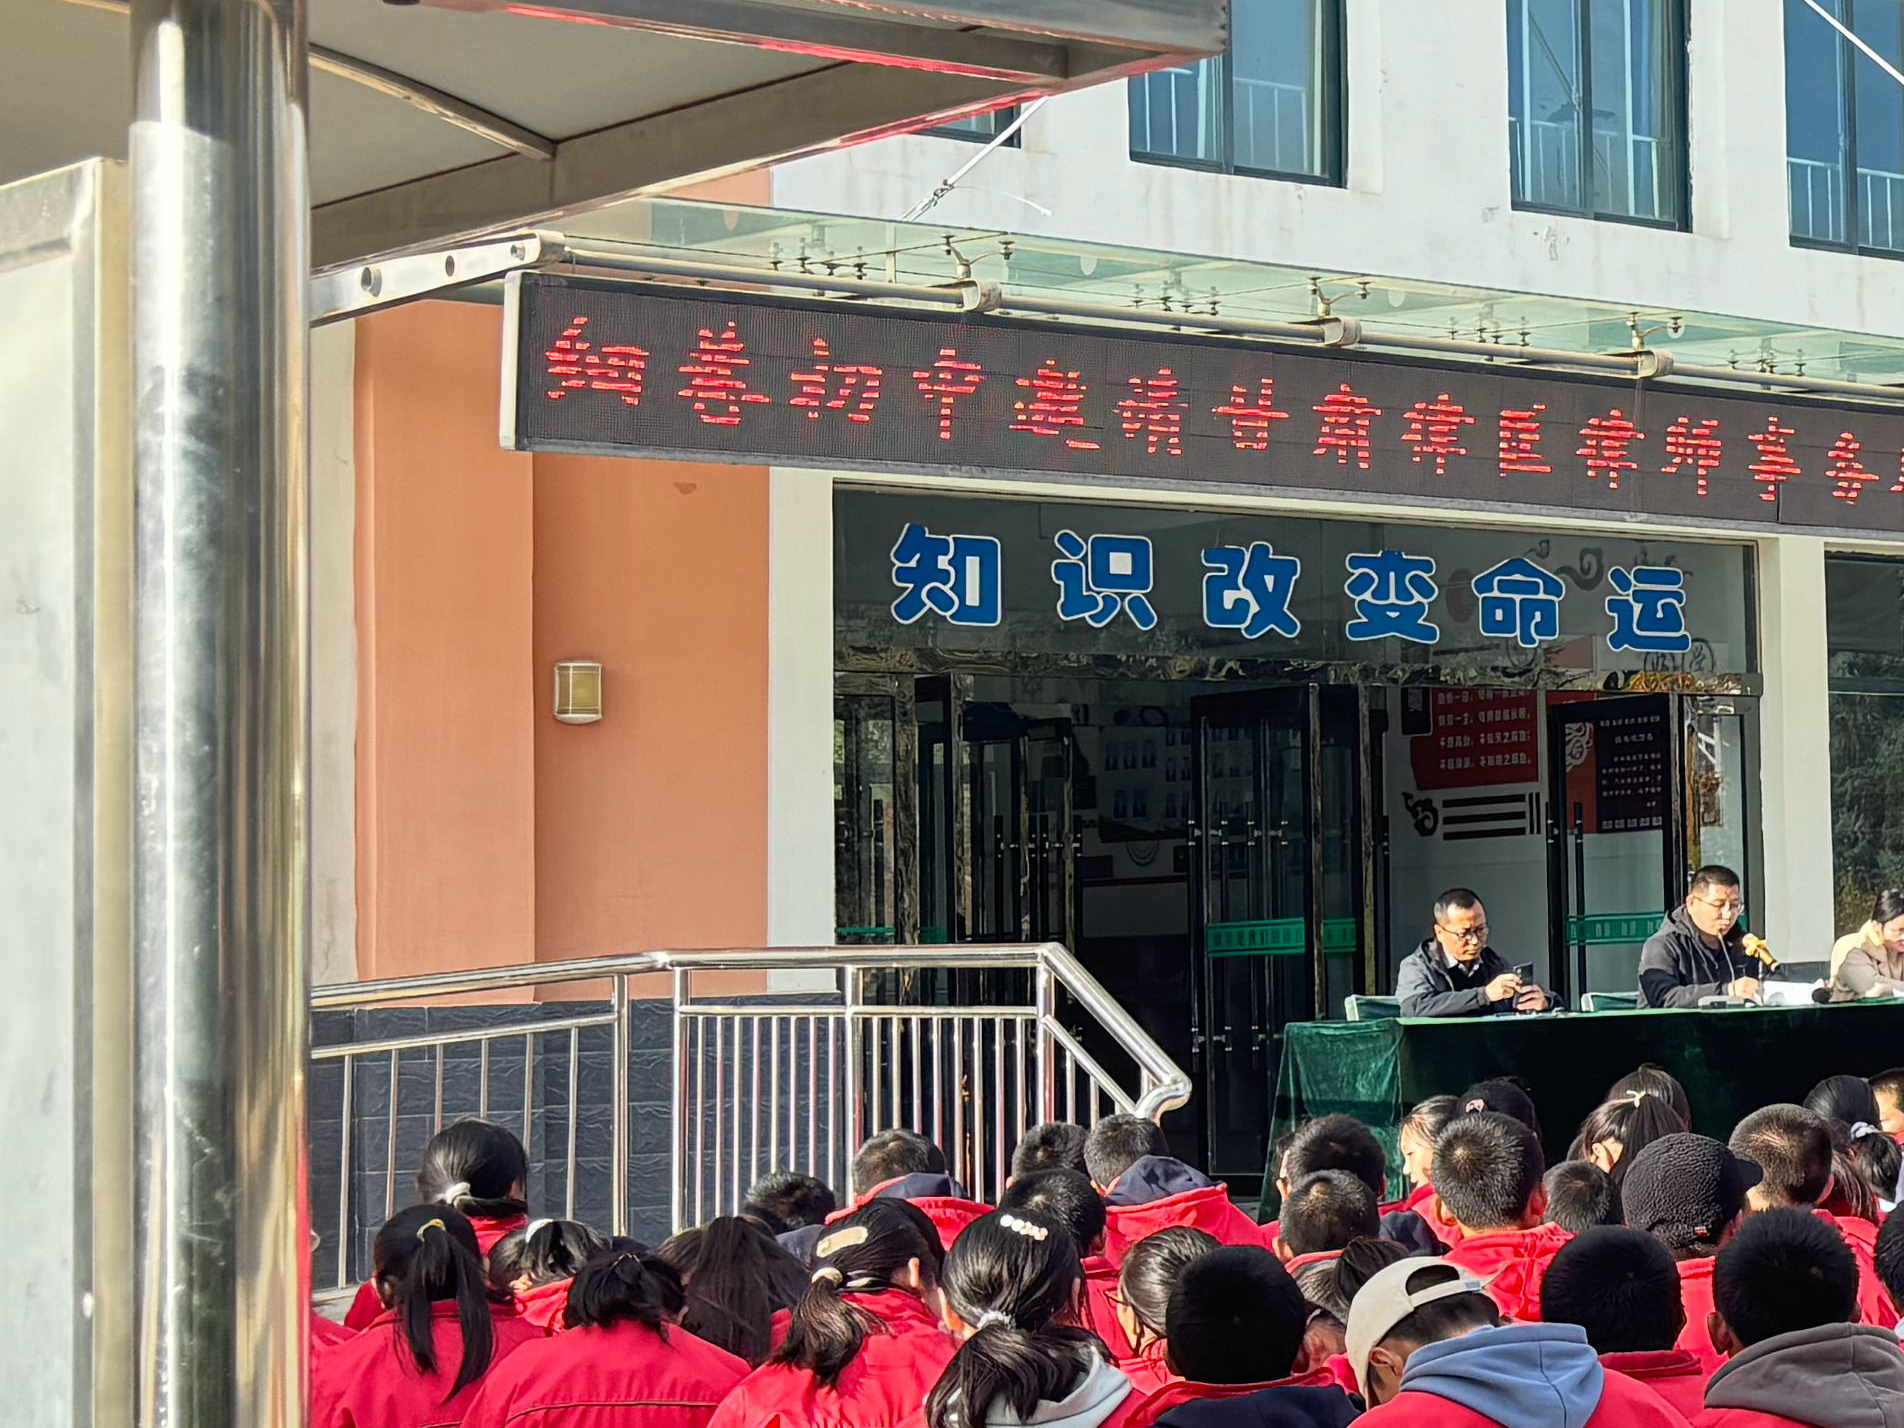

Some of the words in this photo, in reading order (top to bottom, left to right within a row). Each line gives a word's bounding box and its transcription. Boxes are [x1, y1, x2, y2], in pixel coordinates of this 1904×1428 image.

[890, 522, 1692, 654] 知识改变命运
